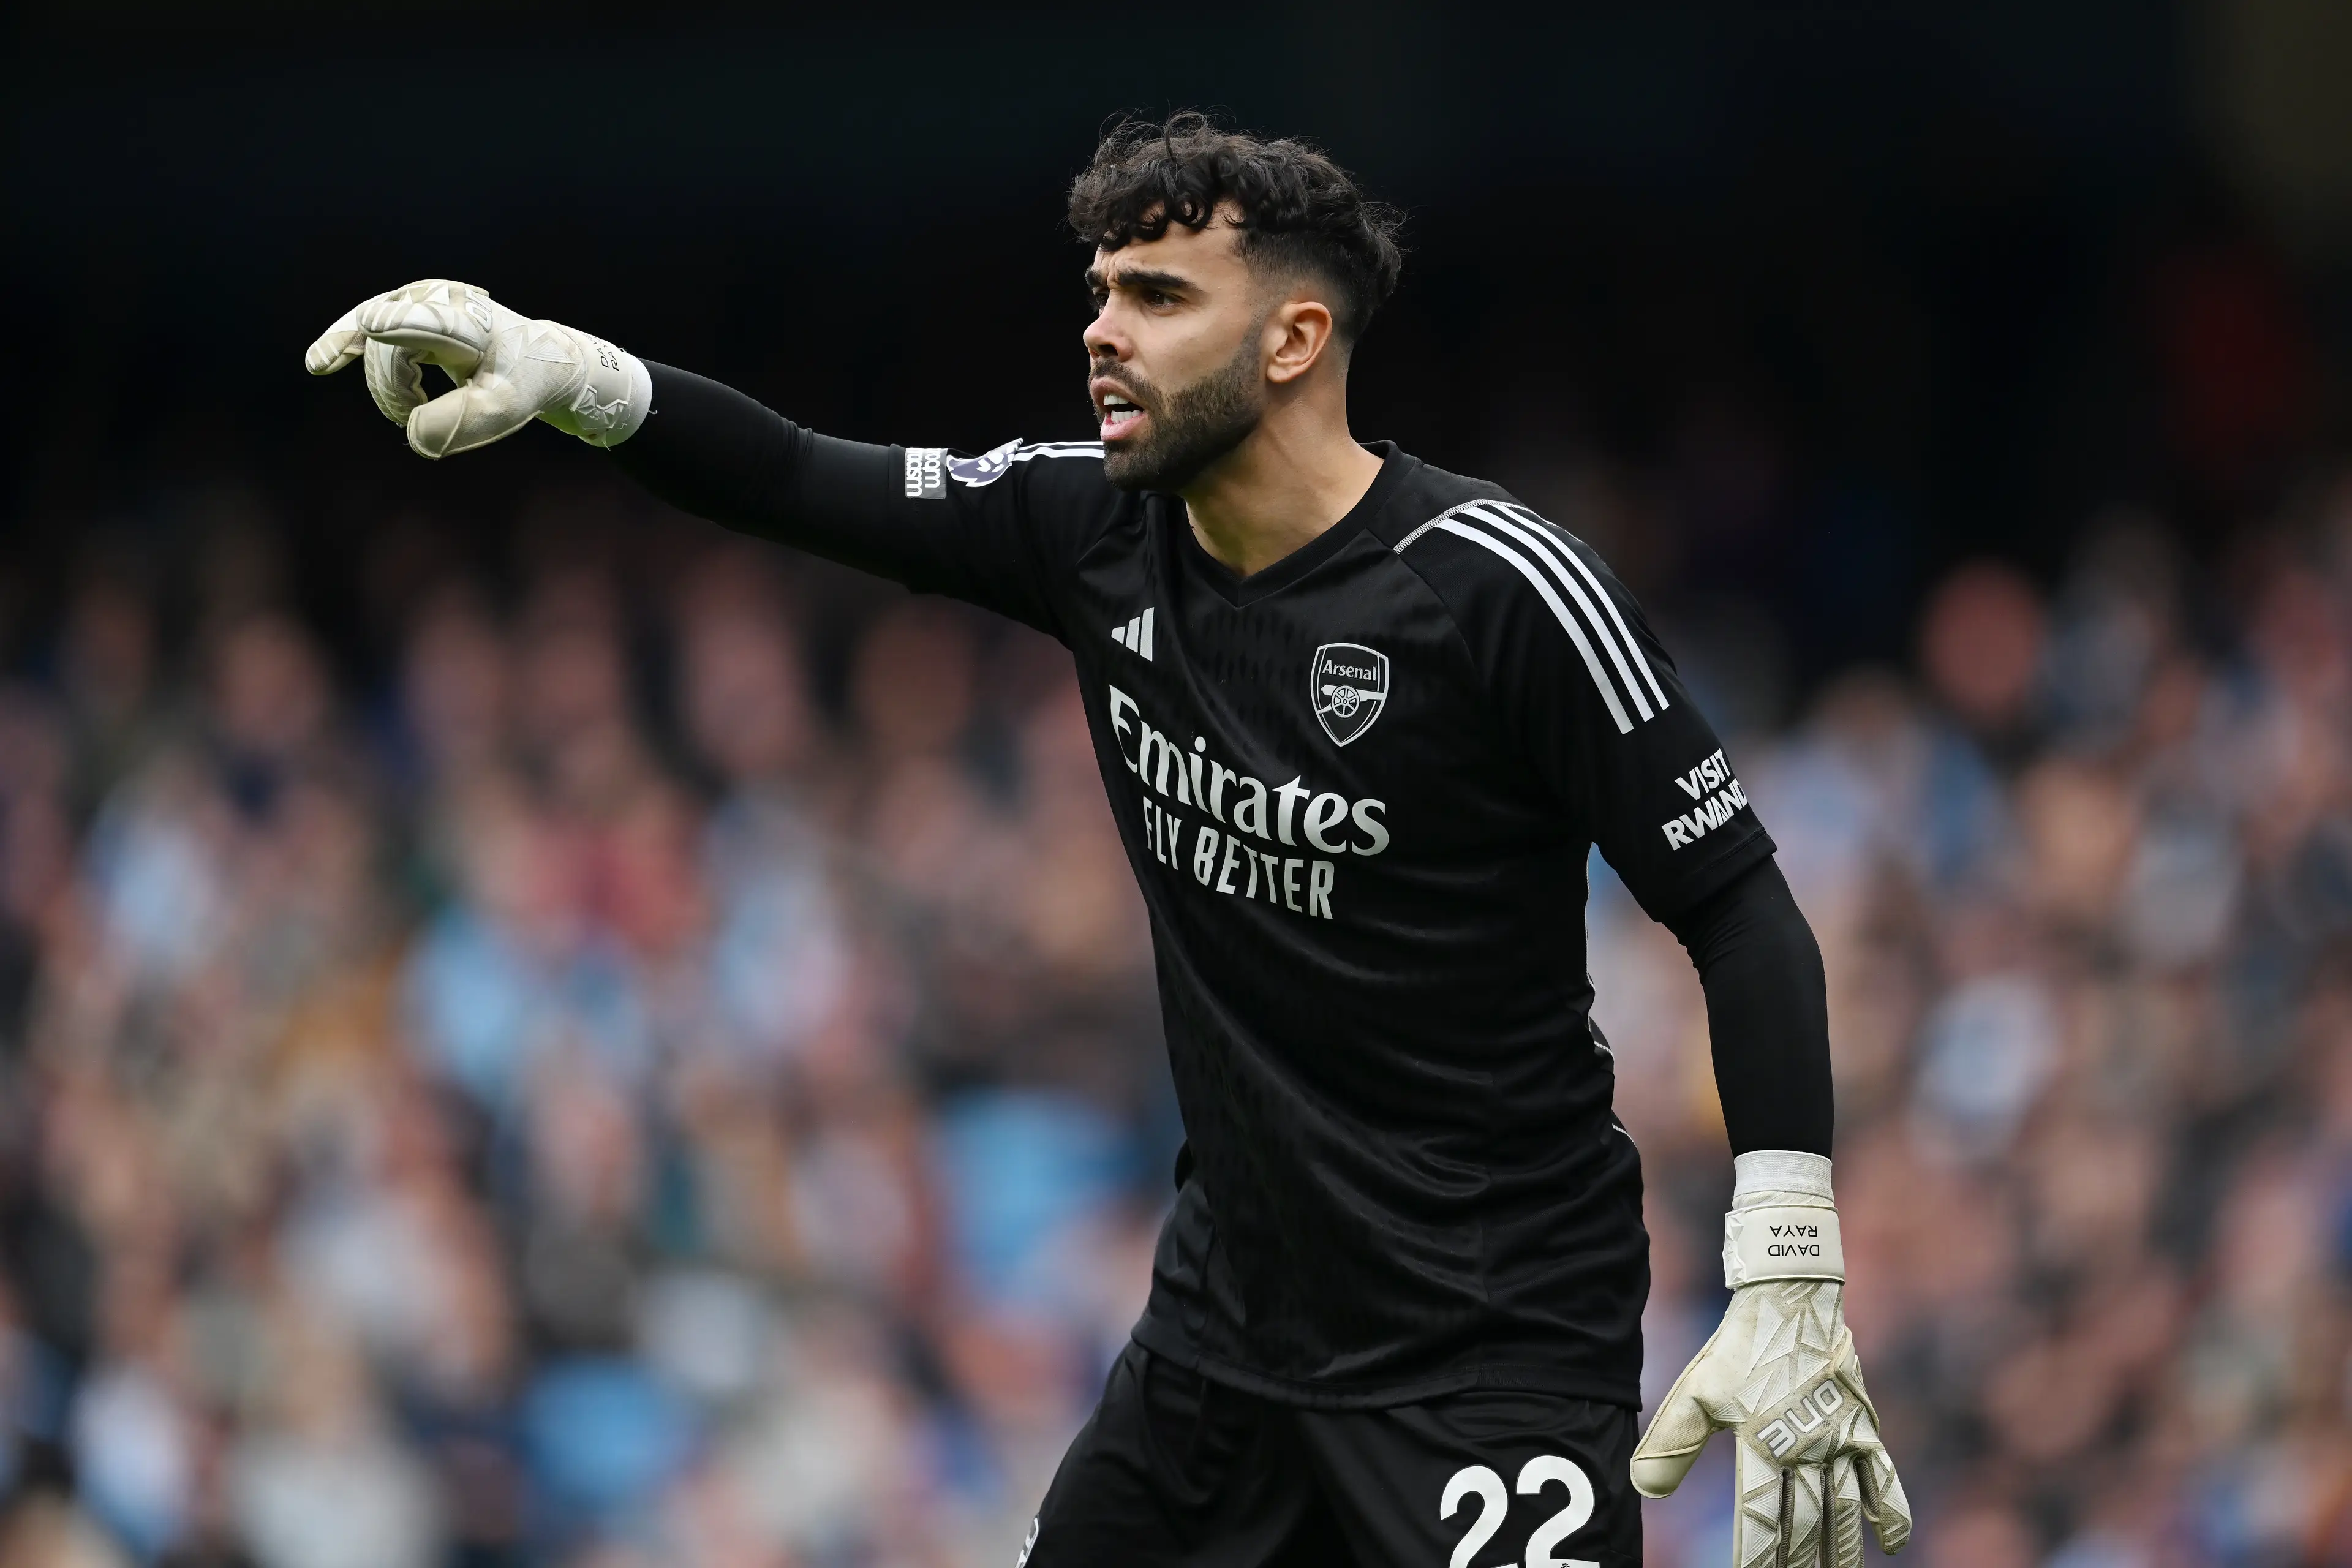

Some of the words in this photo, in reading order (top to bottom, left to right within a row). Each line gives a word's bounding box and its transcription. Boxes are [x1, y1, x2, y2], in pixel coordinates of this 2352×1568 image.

[1321, 660, 1377, 682] Arsenal
[1109, 684, 1390, 856] Emirates
[1674, 748, 1731, 801] VISIT
[1661, 778, 1748, 851] RWAND
[1143, 796, 1182, 870] FLY
[1193, 825, 1335, 919] BETTER
[1768, 1244, 1820, 1257] DAVID
[1769, 1224, 1817, 1237] RAYA
[1440, 1455, 1600, 1568] 22
